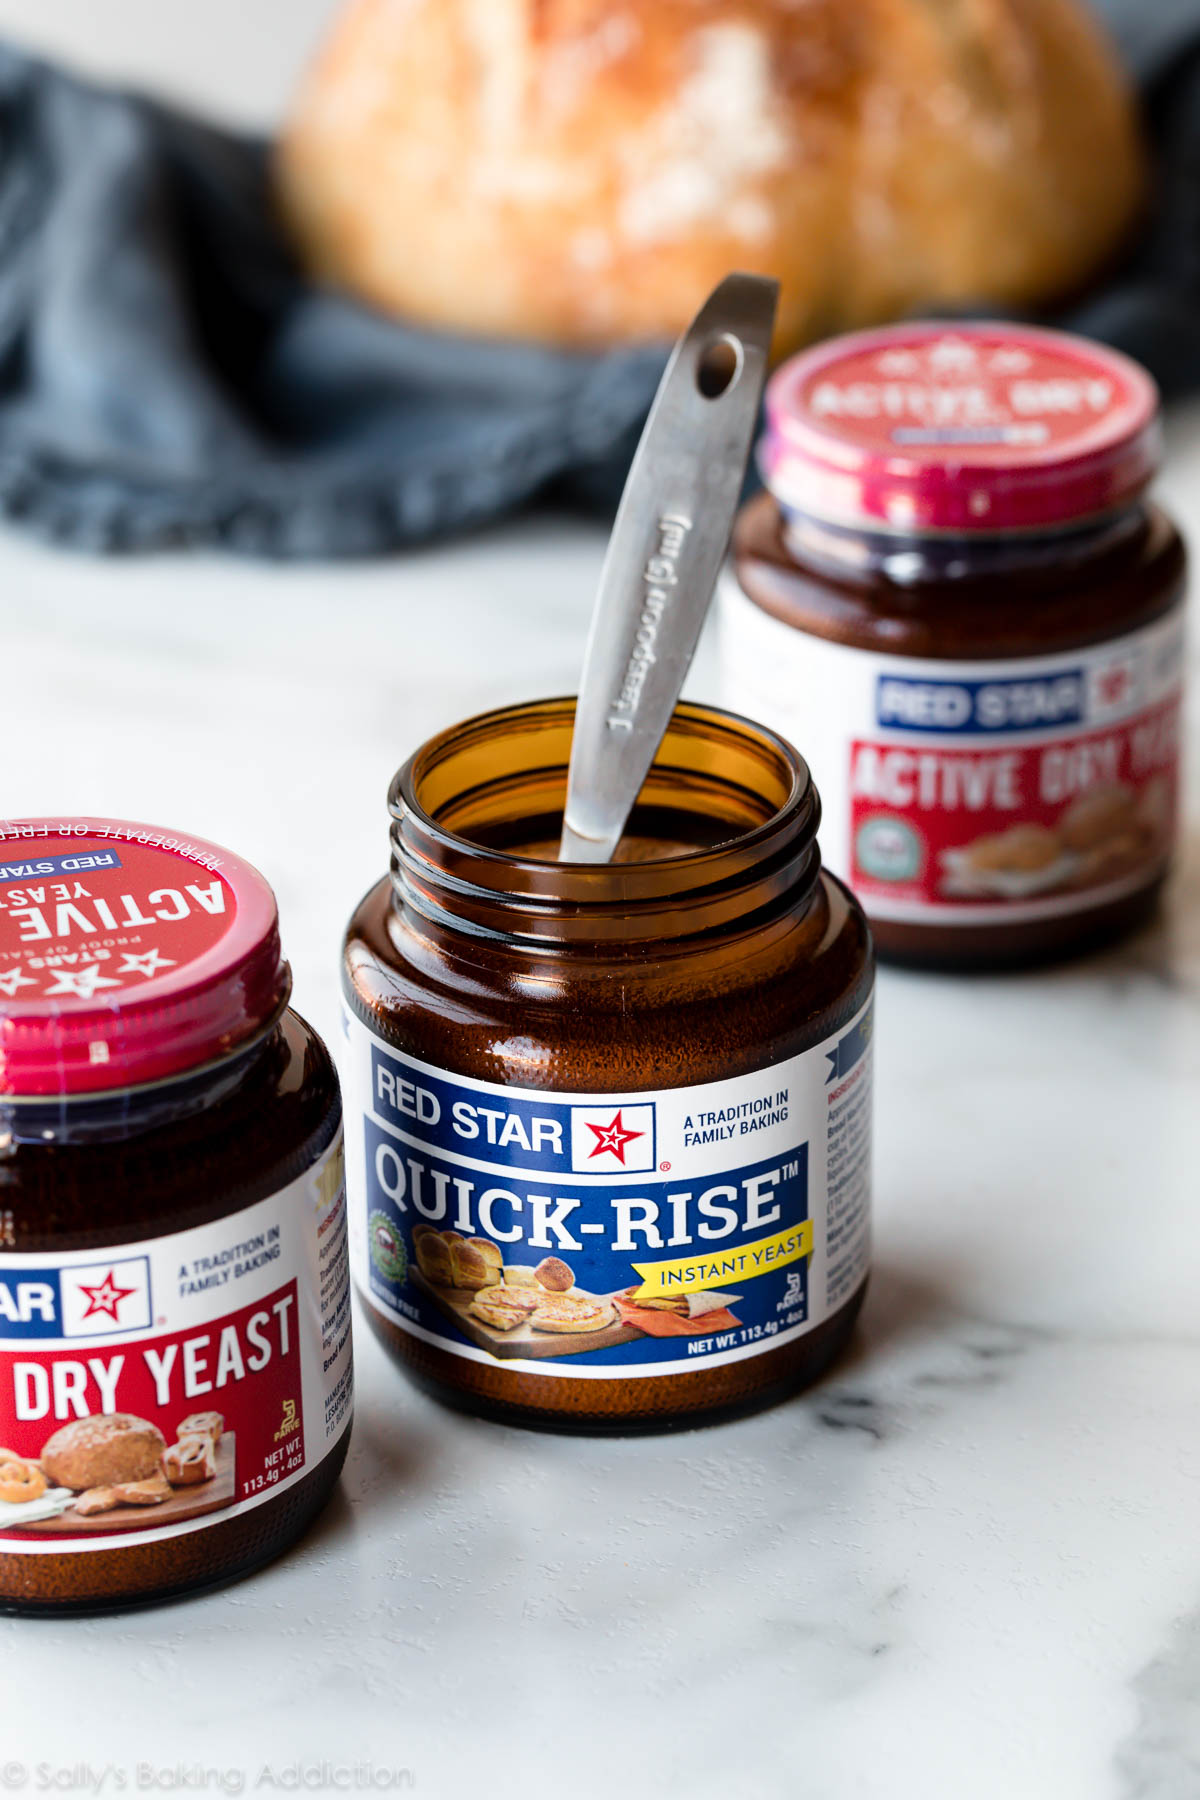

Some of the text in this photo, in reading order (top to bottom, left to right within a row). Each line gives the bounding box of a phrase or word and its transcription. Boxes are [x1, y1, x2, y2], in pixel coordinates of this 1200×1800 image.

[811, 381, 988, 420] ACTIVE
[1011, 378, 1112, 414] DRY
[881, 676, 1080, 728] RED STAR
[852, 746, 1020, 811] ACTIVE
[58, 823, 89, 837] OR
[96, 824, 225, 872] REFRIGERATE
[60, 854, 115, 871] RED
[8, 880, 226, 942] ACTIVE
[27, 948, 112, 970] STARS
[78, 935, 142, 952] PROOF
[376, 1063, 564, 1155] RED STAR
[683, 1088, 789, 1130] A TRADITION IN
[684, 1106, 789, 1147] FAMILY BAKING
[178, 1223, 280, 1279] A TRADITION IN
[179, 1242, 281, 1298] FAMILY BAKING
[660, 1231, 804, 1287] INSTANT YEAST
[13, 1354, 126, 1421] DRY
[142, 1293, 294, 1406] YEAST
[687, 1337, 715, 1355] NET
[715, 1332, 738, 1349] WT.
[740, 1320, 778, 1343] 113.4g
[273, 1417, 301, 1443] PARVE
[242, 1453, 303, 1495] 113.4g 4oz
[264, 1436, 303, 1470] NET WT.
